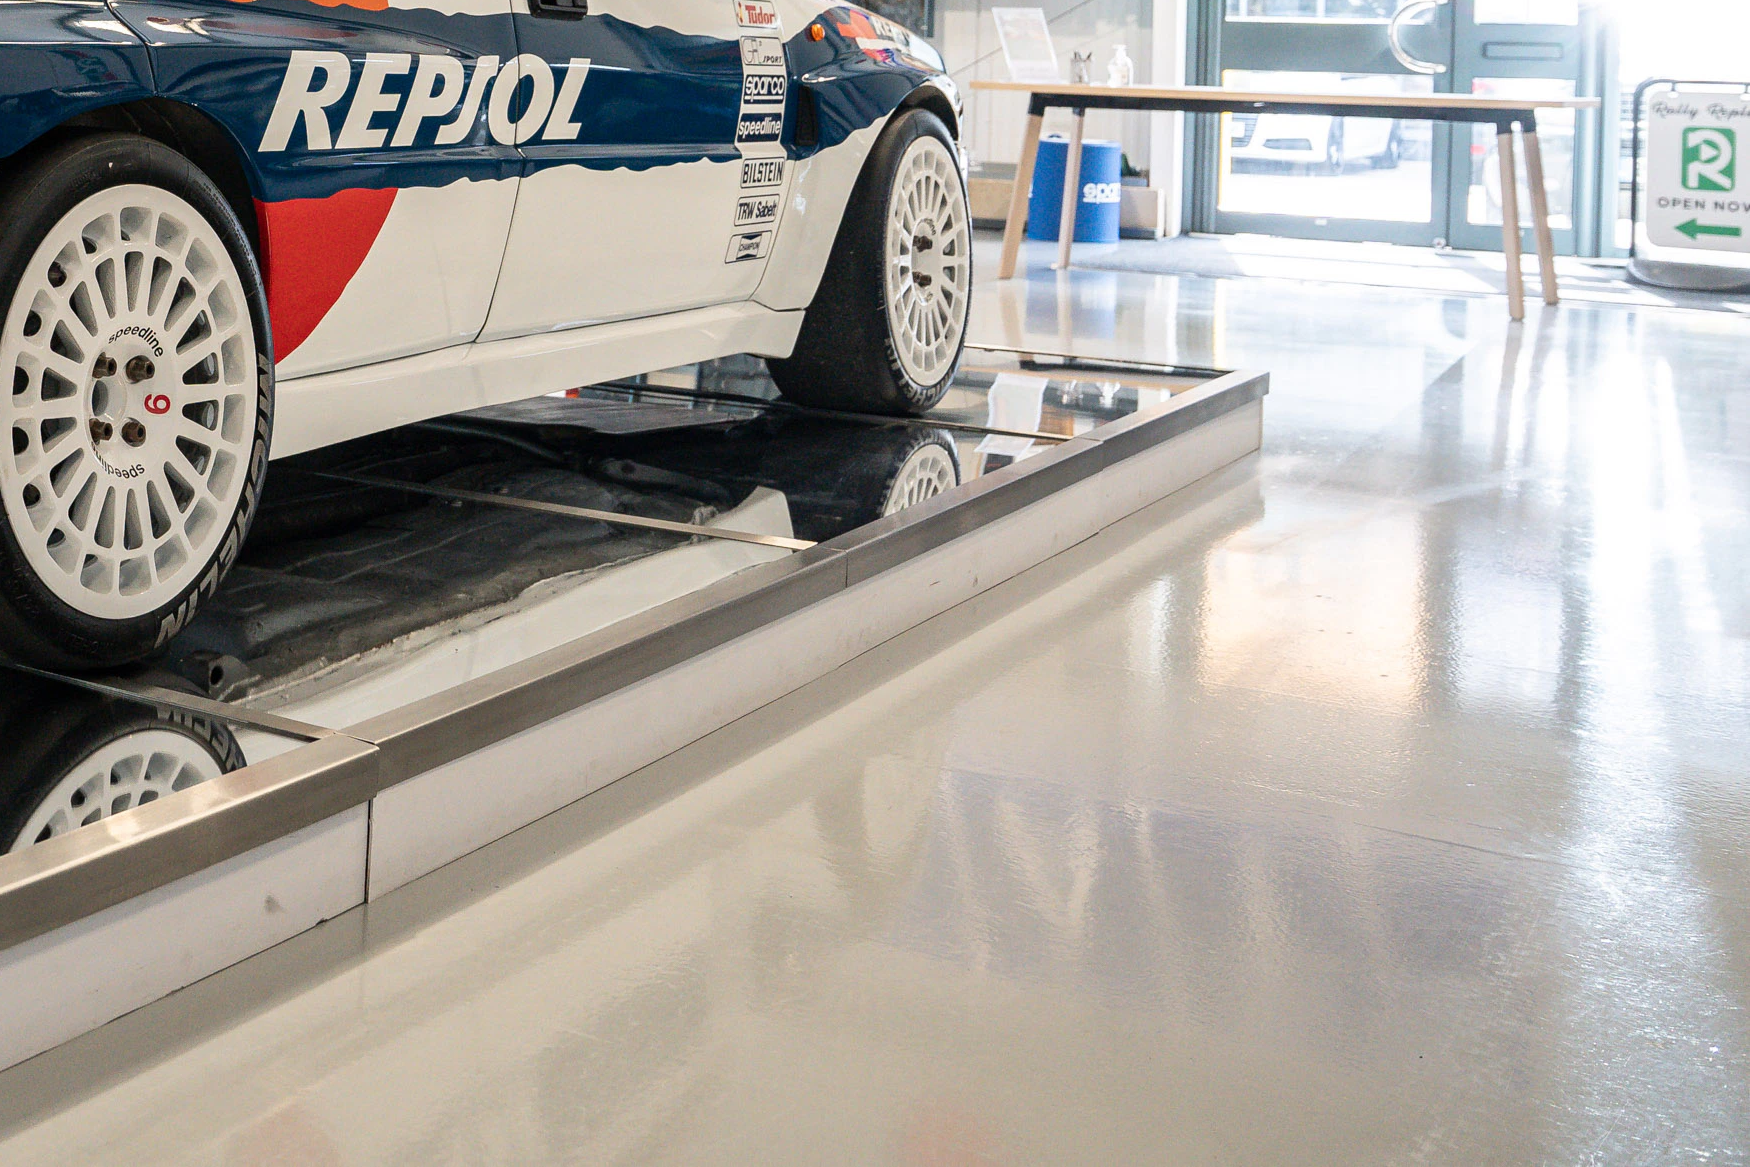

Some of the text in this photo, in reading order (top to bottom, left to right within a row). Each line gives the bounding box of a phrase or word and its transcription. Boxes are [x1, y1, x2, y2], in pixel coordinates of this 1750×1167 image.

[762, 55, 782, 64] SPORT
[746, 76, 784, 102] sparco
[257, 50, 592, 153] REPSOL
[1652, 101, 1698, 120] Rally
[738, 117, 781, 139] speedline
[742, 161, 784, 184] BILSTEIN
[738, 200, 777, 221] TRW Sabelt
[1658, 196, 1706, 210] OPEN
[108, 325, 164, 358] speedline
[154, 352, 270, 650] MICHELIN
